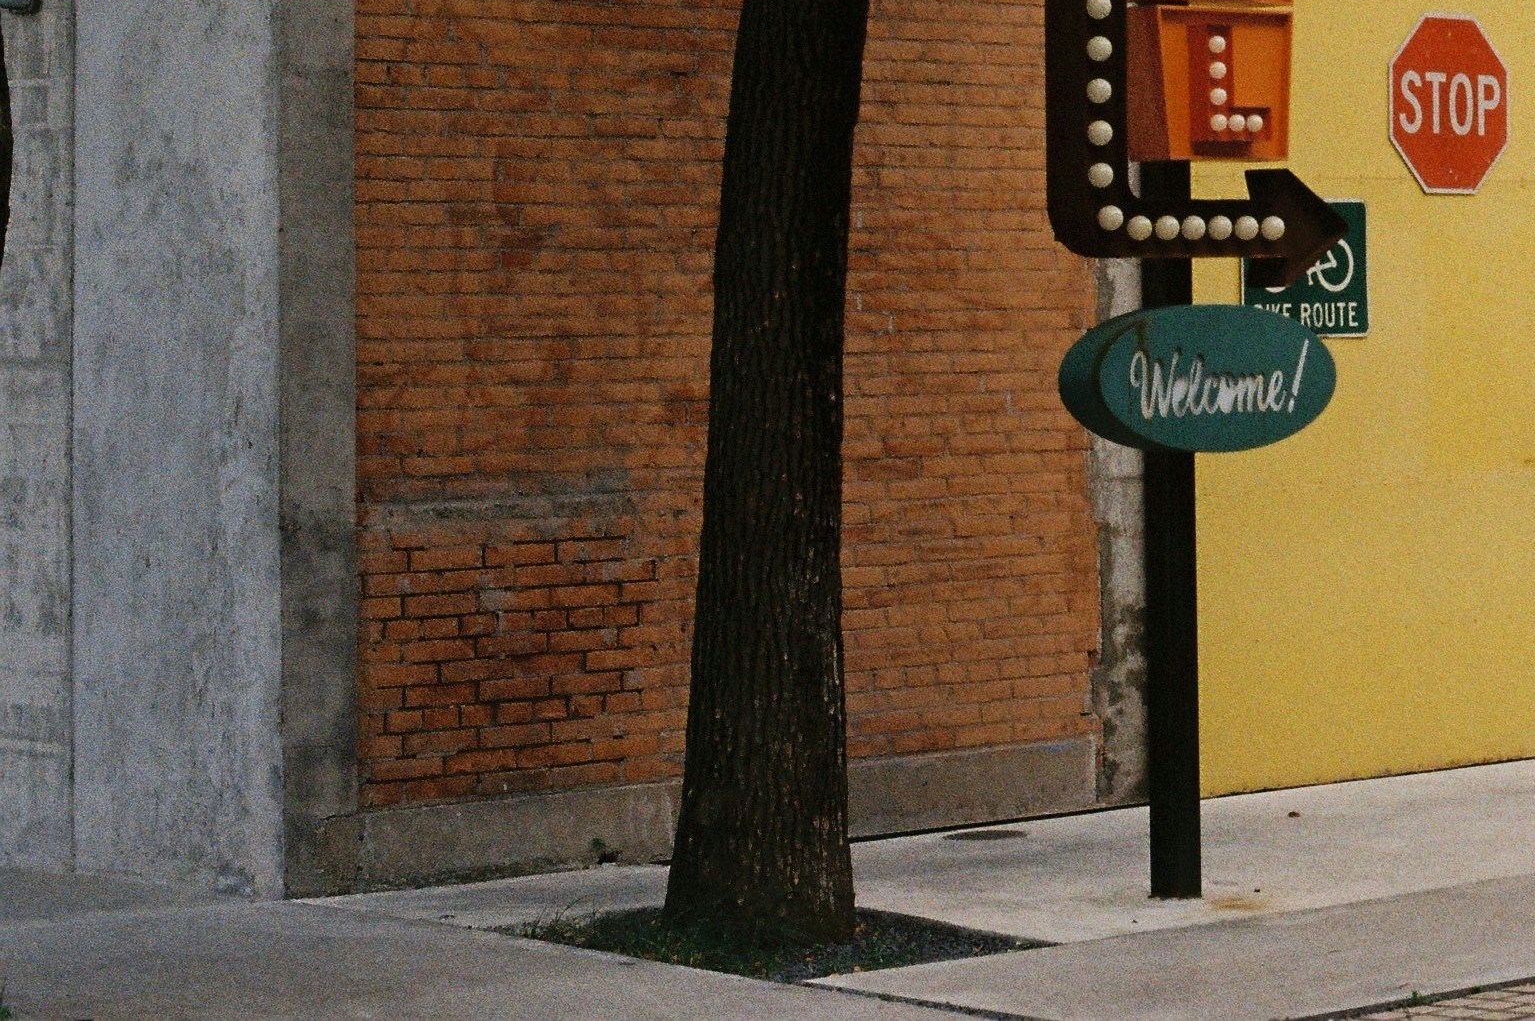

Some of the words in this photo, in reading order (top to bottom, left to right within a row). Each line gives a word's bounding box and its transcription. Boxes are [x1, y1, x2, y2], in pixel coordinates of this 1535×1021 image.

[1399, 69, 1501, 136] STOP
[1300, 301, 1359, 328] ROUTE
[1130, 338, 1309, 420] Welcome!
